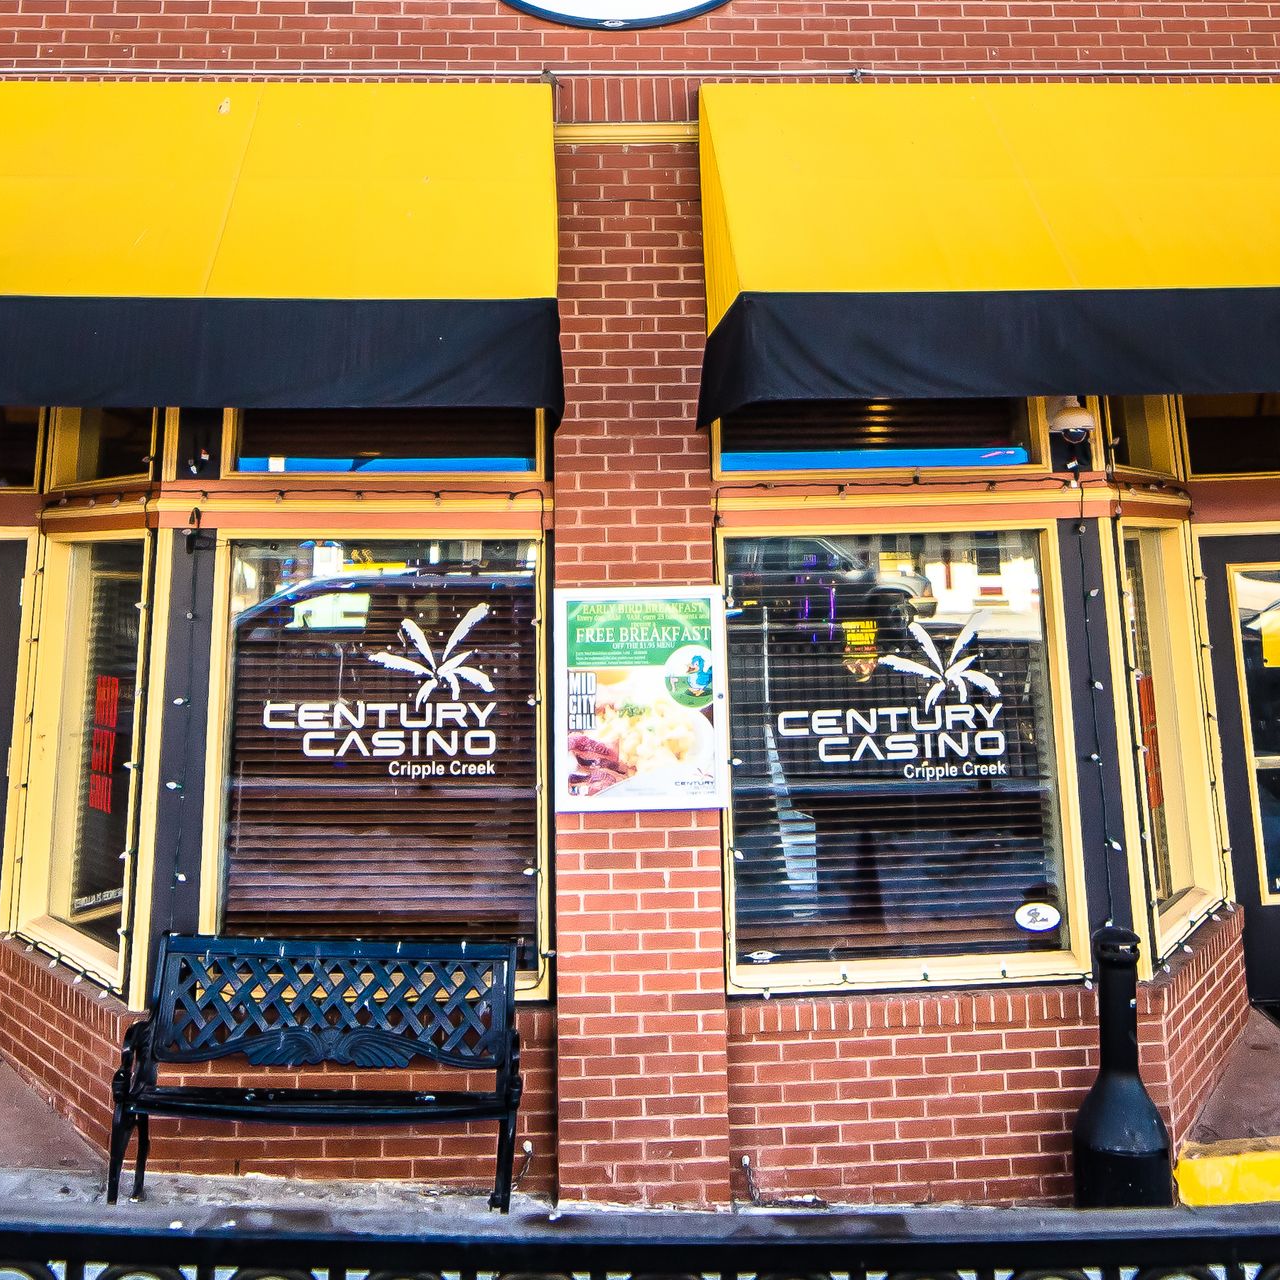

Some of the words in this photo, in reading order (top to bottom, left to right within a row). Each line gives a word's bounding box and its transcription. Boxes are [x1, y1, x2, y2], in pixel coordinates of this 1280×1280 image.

[582, 604, 616, 614] EARLY
[618, 603, 642, 614] BIRD
[646, 602, 704, 614] BREAKFAST
[576, 627, 615, 643] FREE
[619, 626, 711, 643] BREAKFAST
[612, 642, 624, 650] OFF
[626, 641, 638, 650] THE
[657, 641, 676, 649] MENU
[568, 671, 597, 695] MID
[568, 695, 596, 714] CITY
[263, 702, 497, 730] CENTURY
[568, 714, 597, 730] GRILL
[777, 703, 1003, 737] CENTURY
[302, 730, 497, 757] CASINO
[818, 731, 1005, 762] CASINO
[388, 761, 445, 779] Cripple
[449, 760, 496, 775] Creek
[903, 762, 958, 781] Cripple
[962, 760, 1007, 776] Creek
